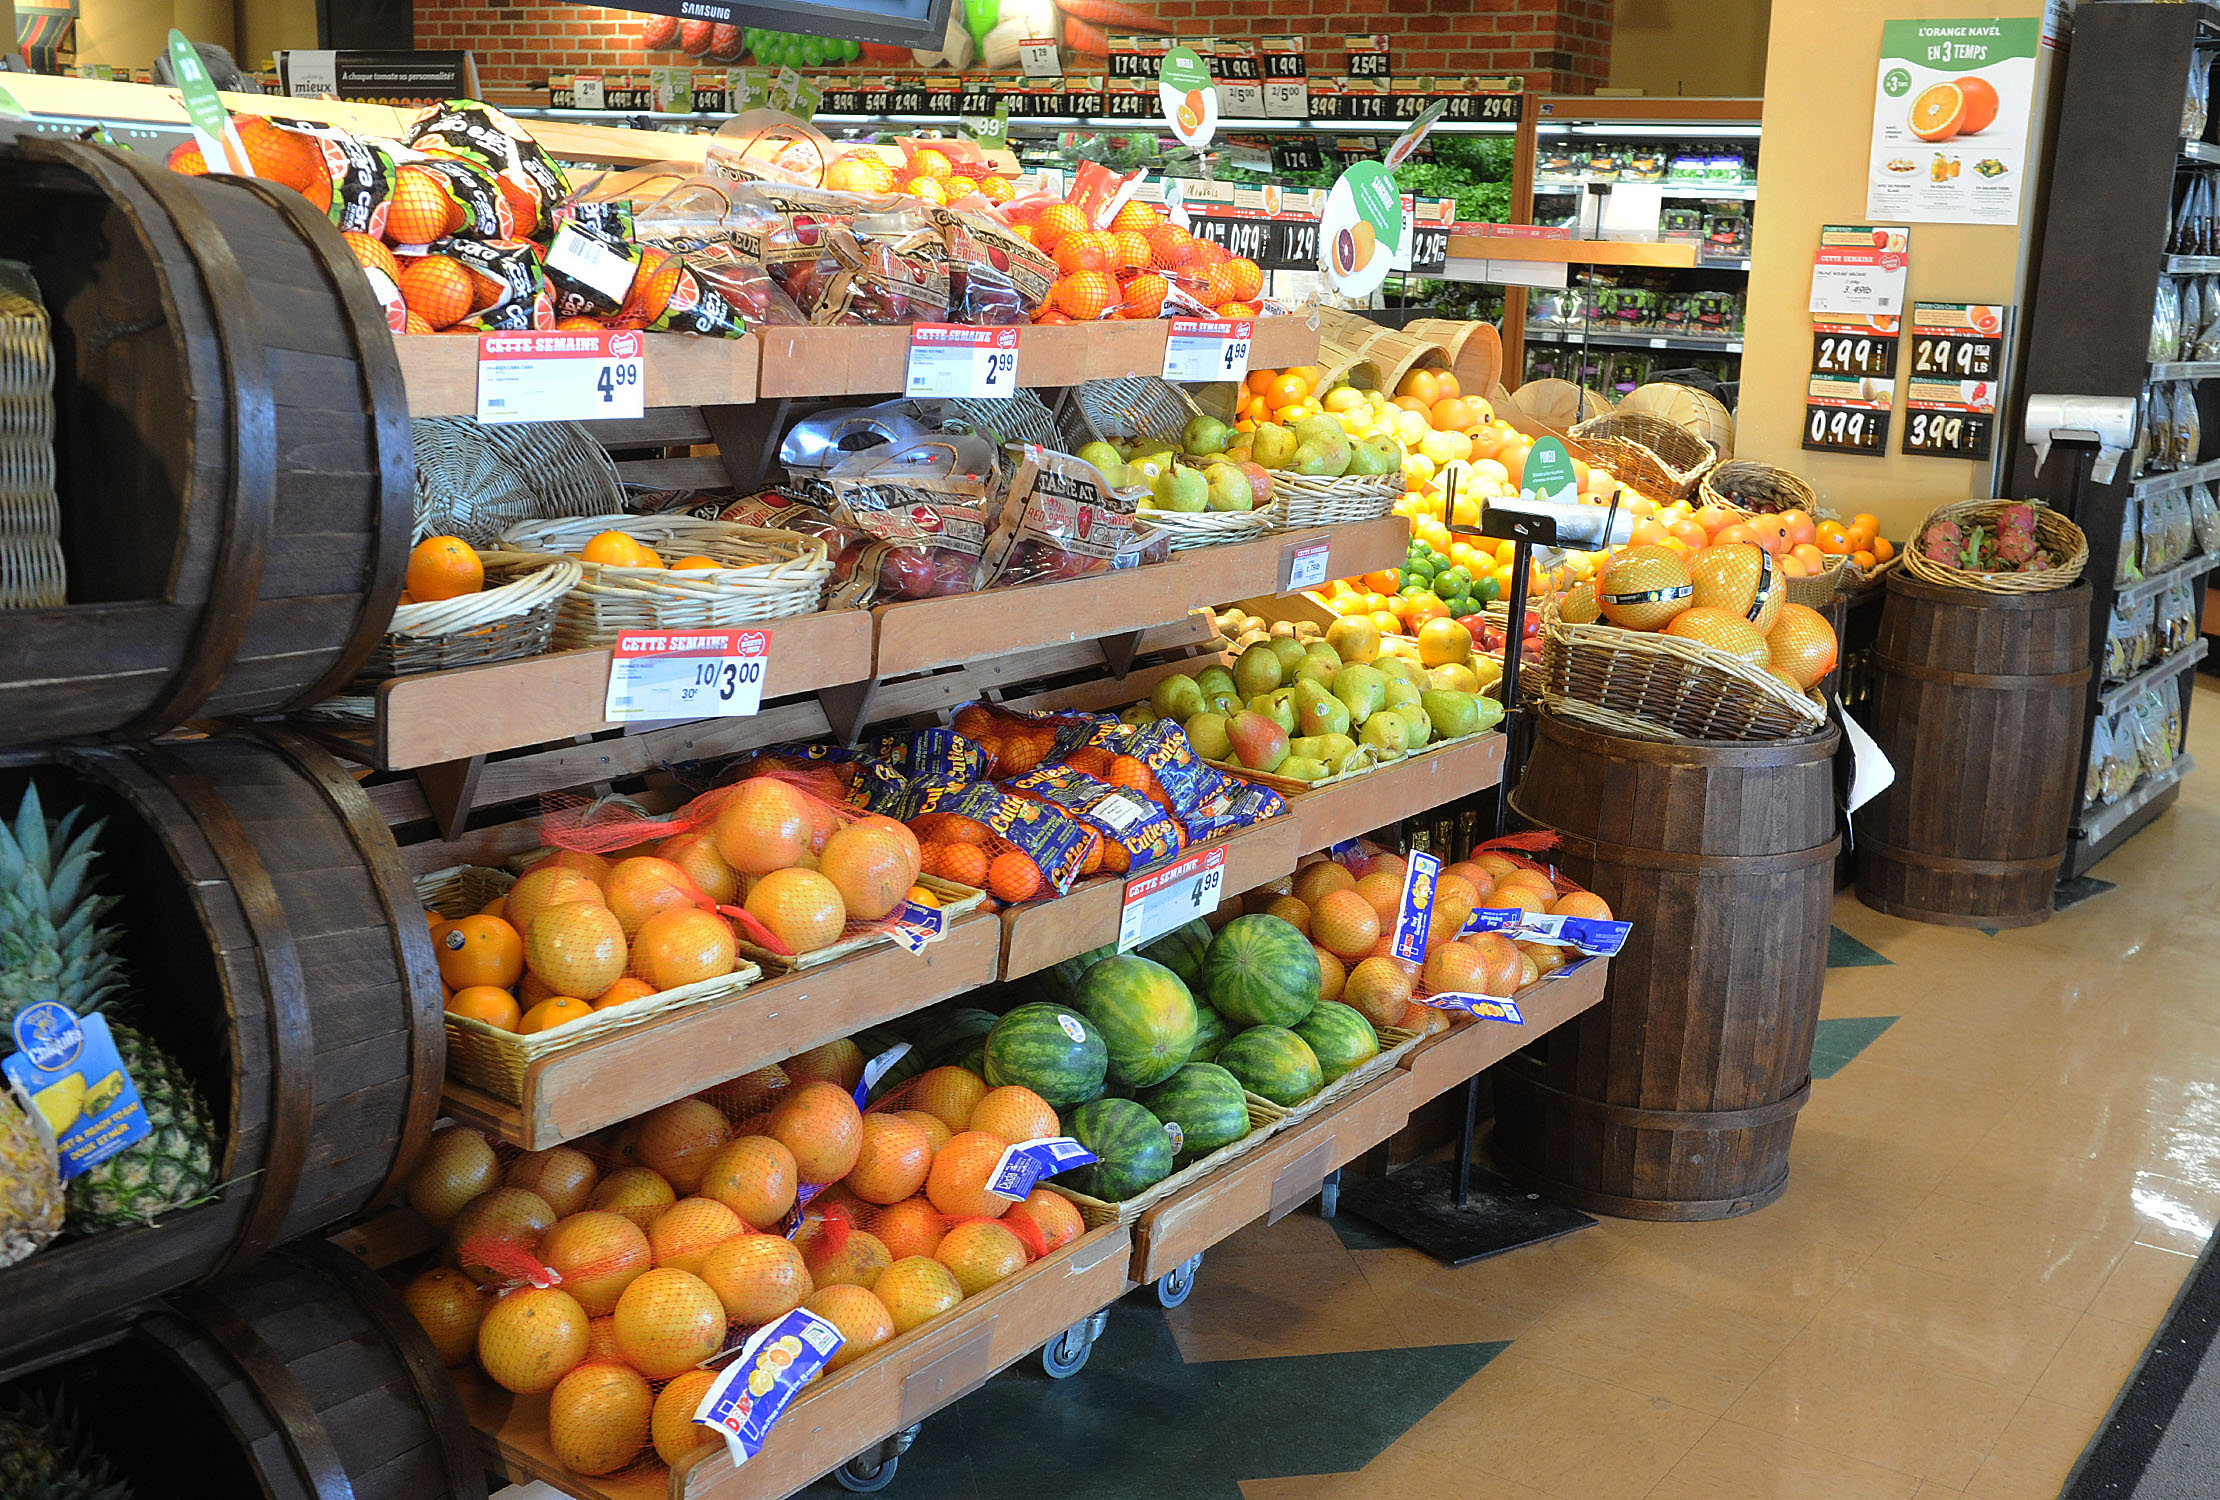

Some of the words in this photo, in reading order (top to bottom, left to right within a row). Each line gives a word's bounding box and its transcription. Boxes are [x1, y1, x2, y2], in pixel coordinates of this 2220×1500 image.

[681, 1, 731, 20] SAMSUNG
[1918, 27, 1967, 37] L'ORANGE
[1968, 26, 2001, 36] NAVEL
[1927, 46, 1940, 61] EN
[1942, 41, 1952, 62] 3
[1953, 44, 1988, 60] TEMPS
[348, 72, 373, 82] chaque
[374, 72, 399, 81] tomate
[1890, 76, 1898, 92] 3
[295, 80, 332, 93] mieux
[453, 238, 500, 261] cara
[916, 328, 948, 341] CETTE
[948, 329, 993, 343] SEMAINE
[1172, 321, 1198, 333] CETTE
[1198, 322, 1232, 334] SEMAINE
[486, 337, 533, 353] CETTE
[534, 336, 600, 352] SEMAINE
[1973, 361, 1988, 374] LB
[1027, 506, 1045, 522] RED
[621, 636, 667, 651] CETTE
[668, 635, 729, 651] SEMAINE
[947, 735, 967, 782] Cuties
[1015, 765, 1071, 789] Cuties
[1122, 819, 1172, 855] Cuties
[1128, 876, 1159, 898] CETTE
[1159, 858, 1199, 886] SEMAINE
[27, 1028, 85, 1066] Chiquita
[84, 1116, 113, 1138] READY
[112, 1111, 124, 1124] TO
[123, 1100, 140, 1117] EAT
[69, 1142, 97, 1161] DOUX
[96, 1133, 109, 1147] ET
